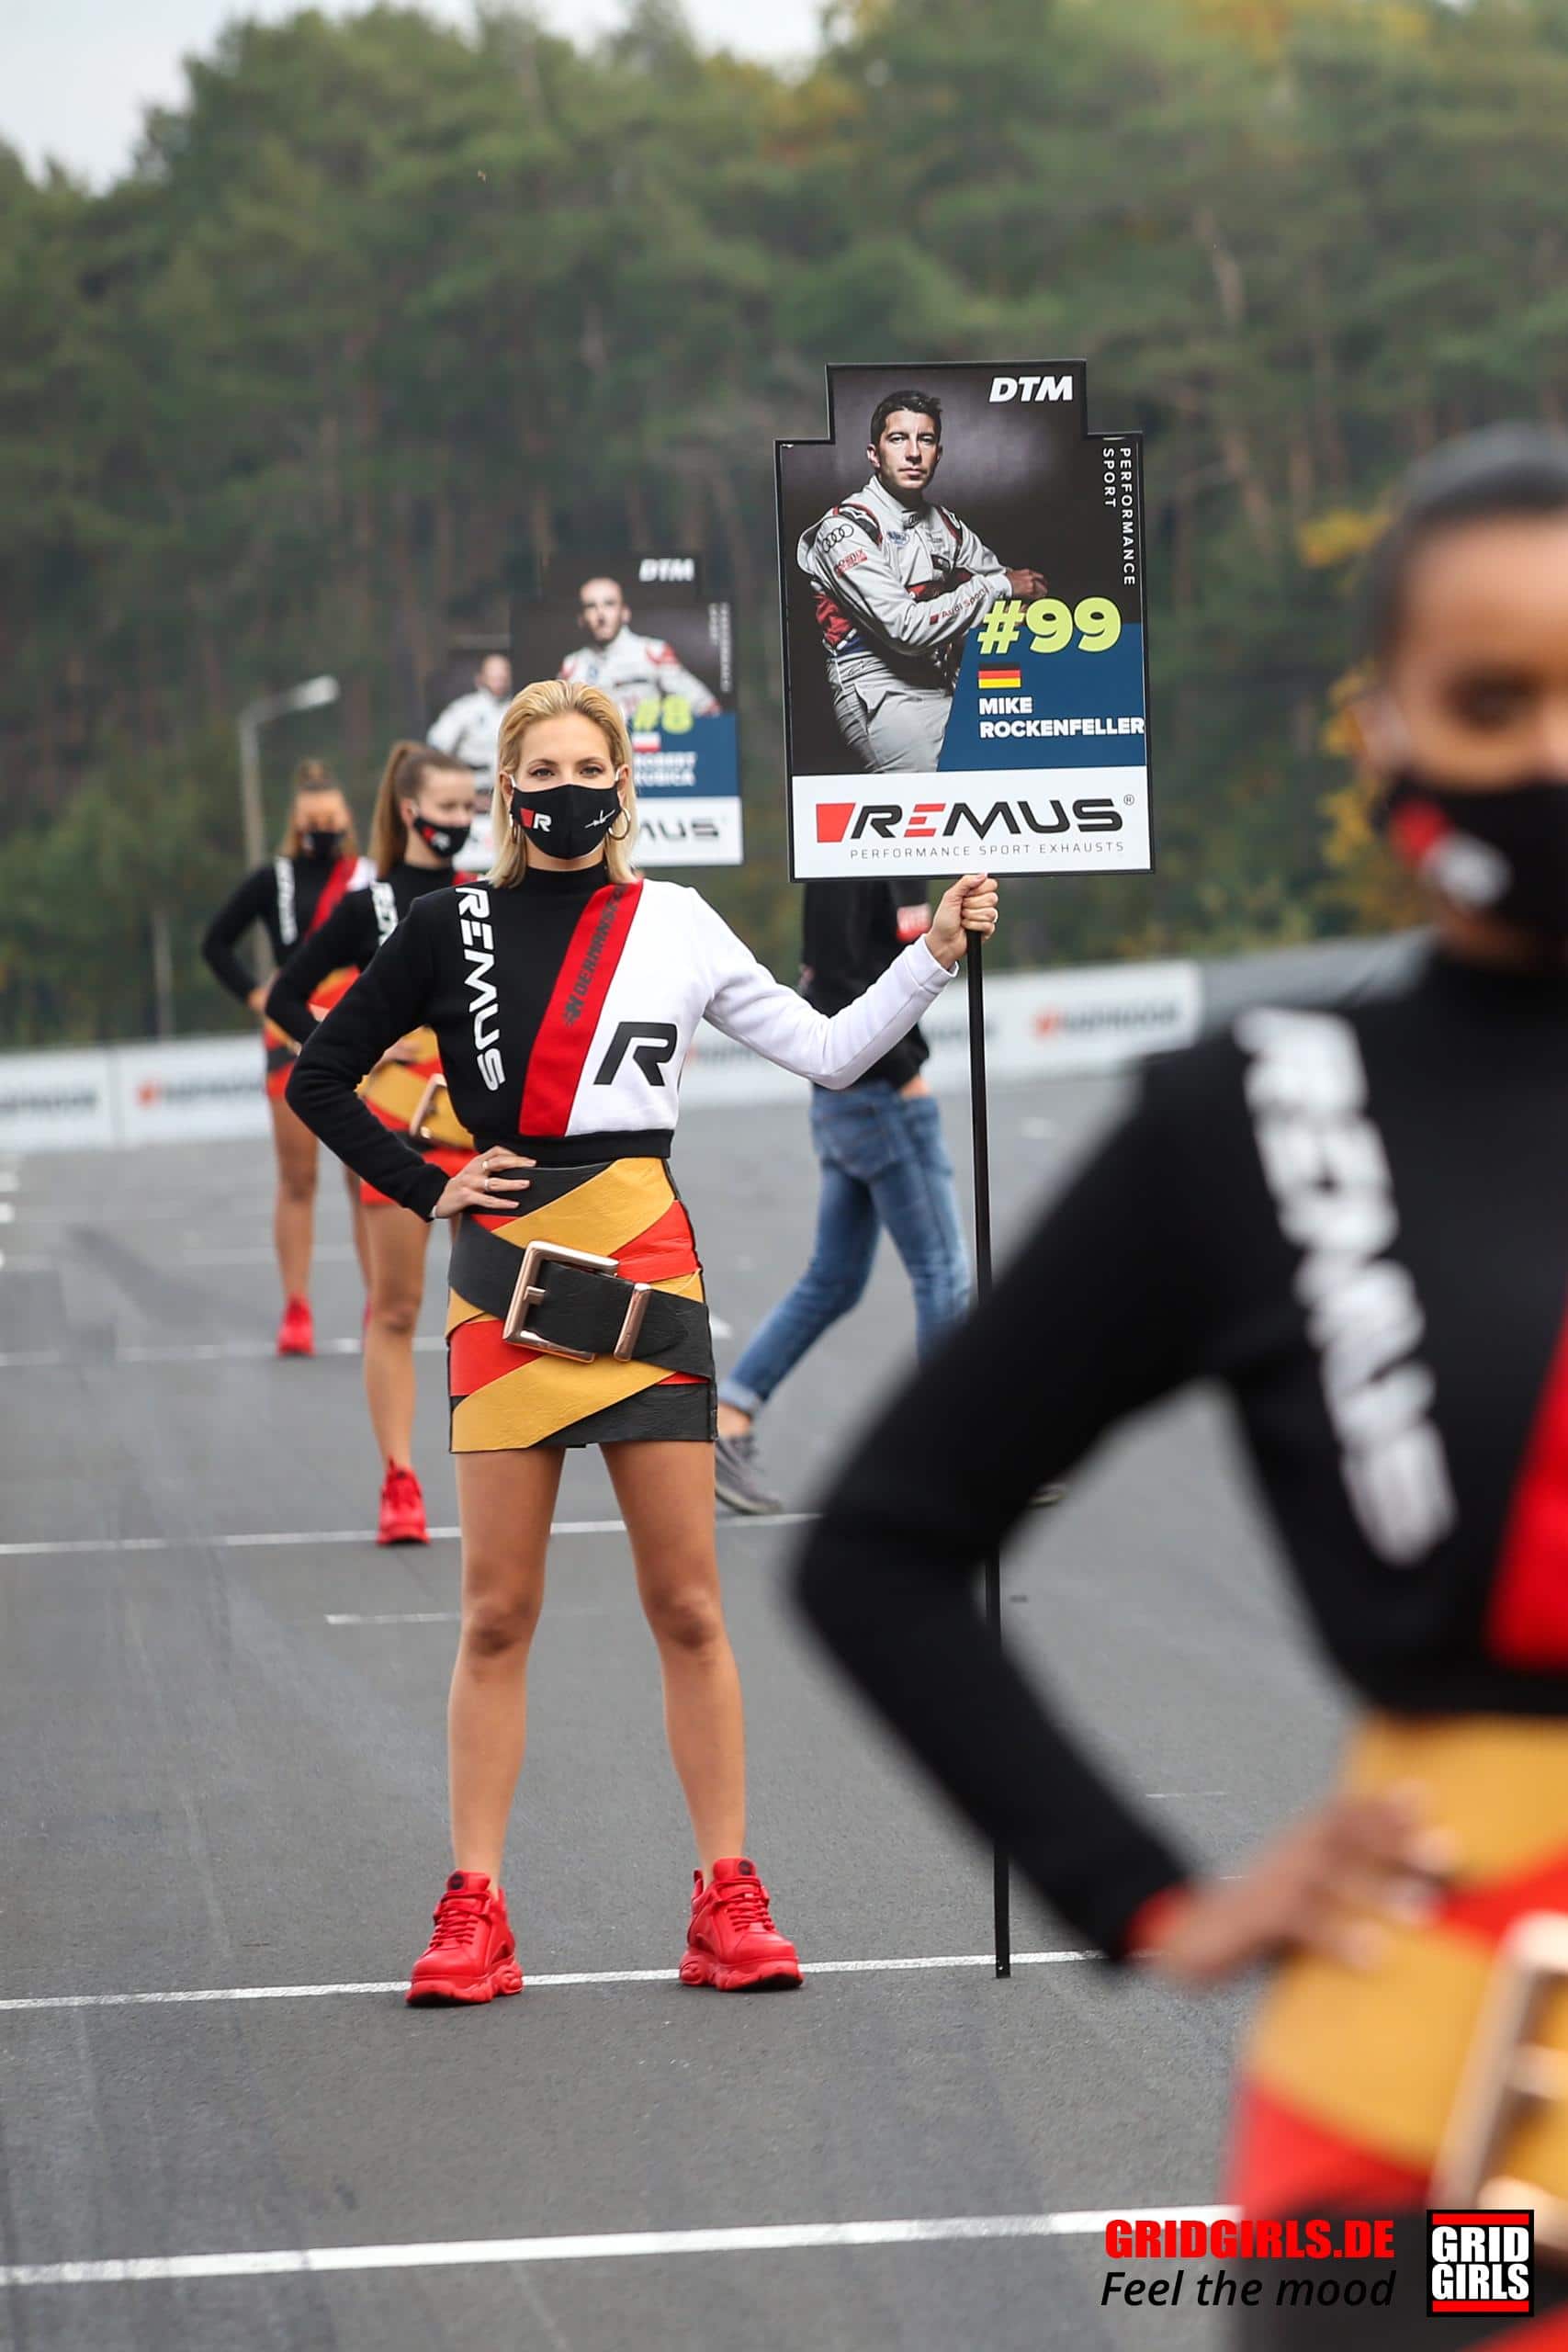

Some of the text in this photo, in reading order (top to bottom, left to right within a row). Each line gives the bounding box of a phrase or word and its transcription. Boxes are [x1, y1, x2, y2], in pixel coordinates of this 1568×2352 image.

[989, 375, 1073, 402] DTM
[1103, 447, 1117, 507] SPORT
[1120, 447, 1136, 585] PERFORMANCE
[976, 596, 1122, 655] #99
[978, 696, 1032, 715] MIKE
[979, 717, 1145, 739] ROCKENFELLER
[851, 798, 1123, 840] REMUS
[850, 841, 1124, 860] PERFORMANCE SPORT EXHAUSTS
[456, 887, 506, 1091] REMUS
[593, 1022, 677, 1087] R
